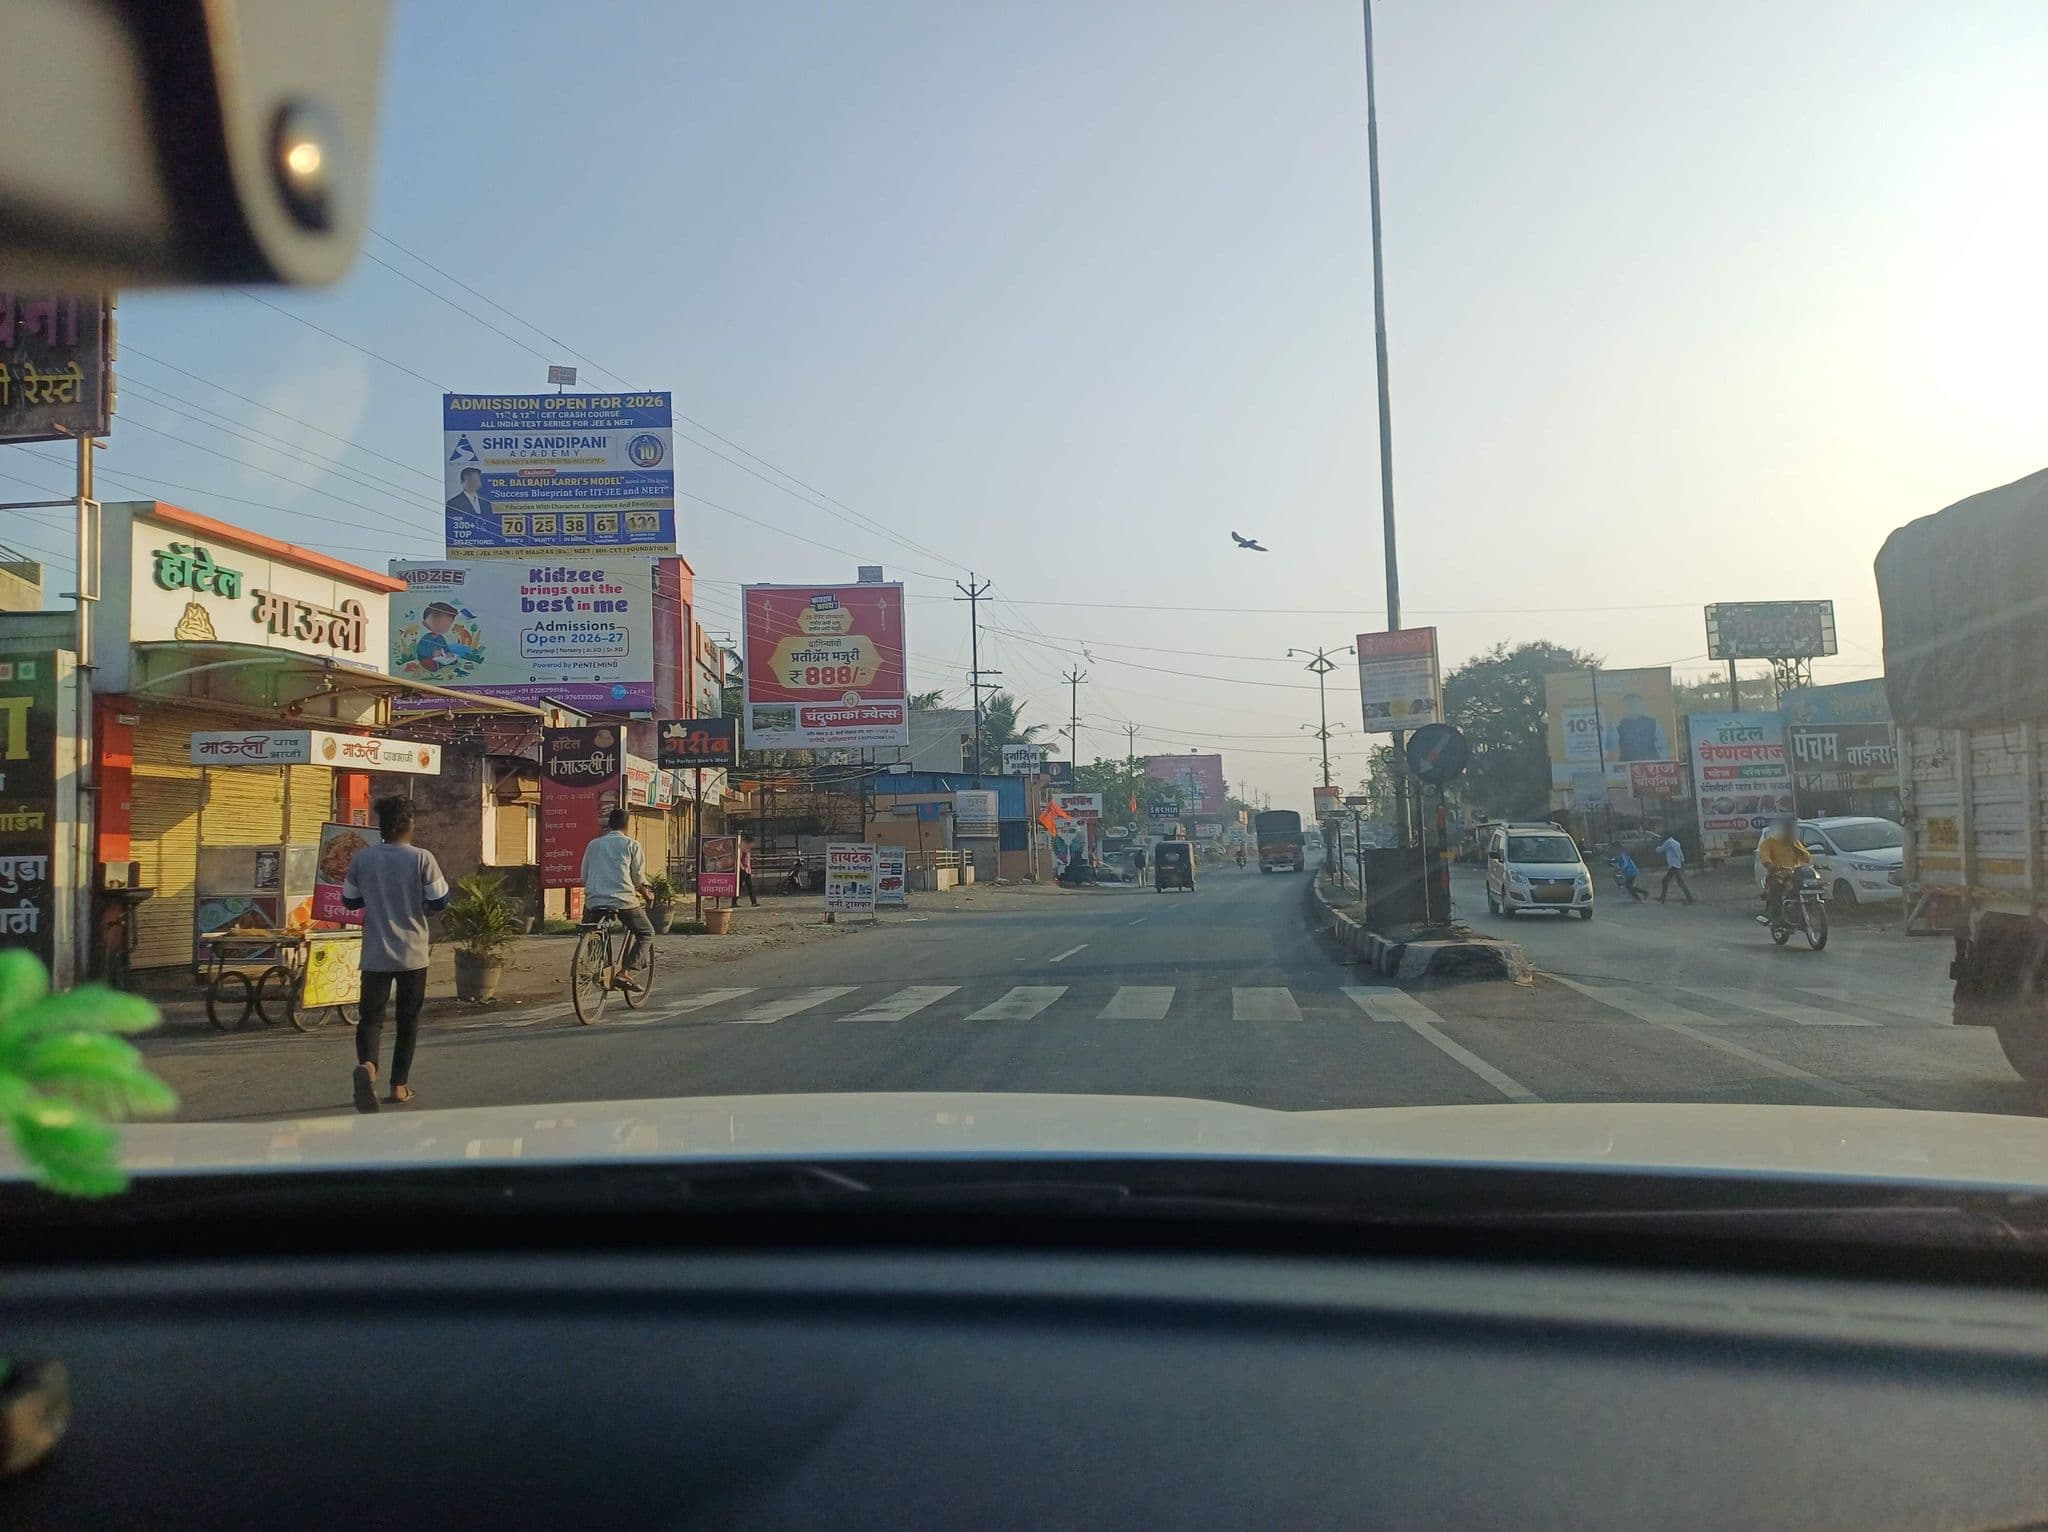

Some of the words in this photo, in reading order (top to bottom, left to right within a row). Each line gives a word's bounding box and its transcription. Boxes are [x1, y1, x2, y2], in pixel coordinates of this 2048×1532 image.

[24, 361, 84, 403] रेस्टो
[450, 398, 540, 410] ADMISSION
[544, 398, 586, 410] OPEN
[591, 397, 622, 409] FOR
[625, 396, 664, 408] 2026
[541, 411, 557, 419] CET
[588, 410, 620, 418] COURSE
[481, 420, 497, 428] ALL
[499, 420, 518, 428] INDIA
[520, 420, 540, 428] TEST
[542, 420, 571, 428] SERIES
[614, 418, 634, 426] NEET
[482, 437, 518, 450] SHRI
[523, 436, 606, 449] SANDIPANI
[510, 450, 580, 458] ACADEMY
[510, 478, 549, 487] BALRAJU
[532, 489, 572, 498] Blueprint
[575, 488, 588, 496] for
[590, 488, 622, 496] IIT-JEE
[624, 487, 639, 495] and
[504, 521, 523, 533] 70
[535, 520, 554, 532] 25
[565, 520, 584, 532] 38
[454, 530, 472, 538] TOP
[152, 542, 243, 599] हॉटेल
[399, 569, 465, 584] KIDZEE
[529, 567, 605, 583] Kidzee
[520, 585, 568, 597] brings
[571, 585, 594, 594] out
[599, 584, 622, 594] the
[521, 597, 575, 614] best
[577, 600, 590, 611] in
[594, 600, 628, 613] me
[250, 589, 368, 652] माऊली
[535, 620, 616, 632] Admissions
[526, 633, 566, 645] Open
[806, 710, 858, 726] चंदुकाका
[862, 707, 897, 719] ज्वेल्स
[1716, 720, 1764, 744] हॉटेल
[200, 736, 269, 758] माऊली
[274, 738, 299, 746] पाव
[552, 736, 581, 750] हॉटेल
[664, 730, 730, 755] गरीब
[270, 750, 300, 758] भाजी
[342, 740, 381, 764] माऊली
[383, 750, 413, 764] पावभाजी
[830, 848, 872, 864] हायटेक
